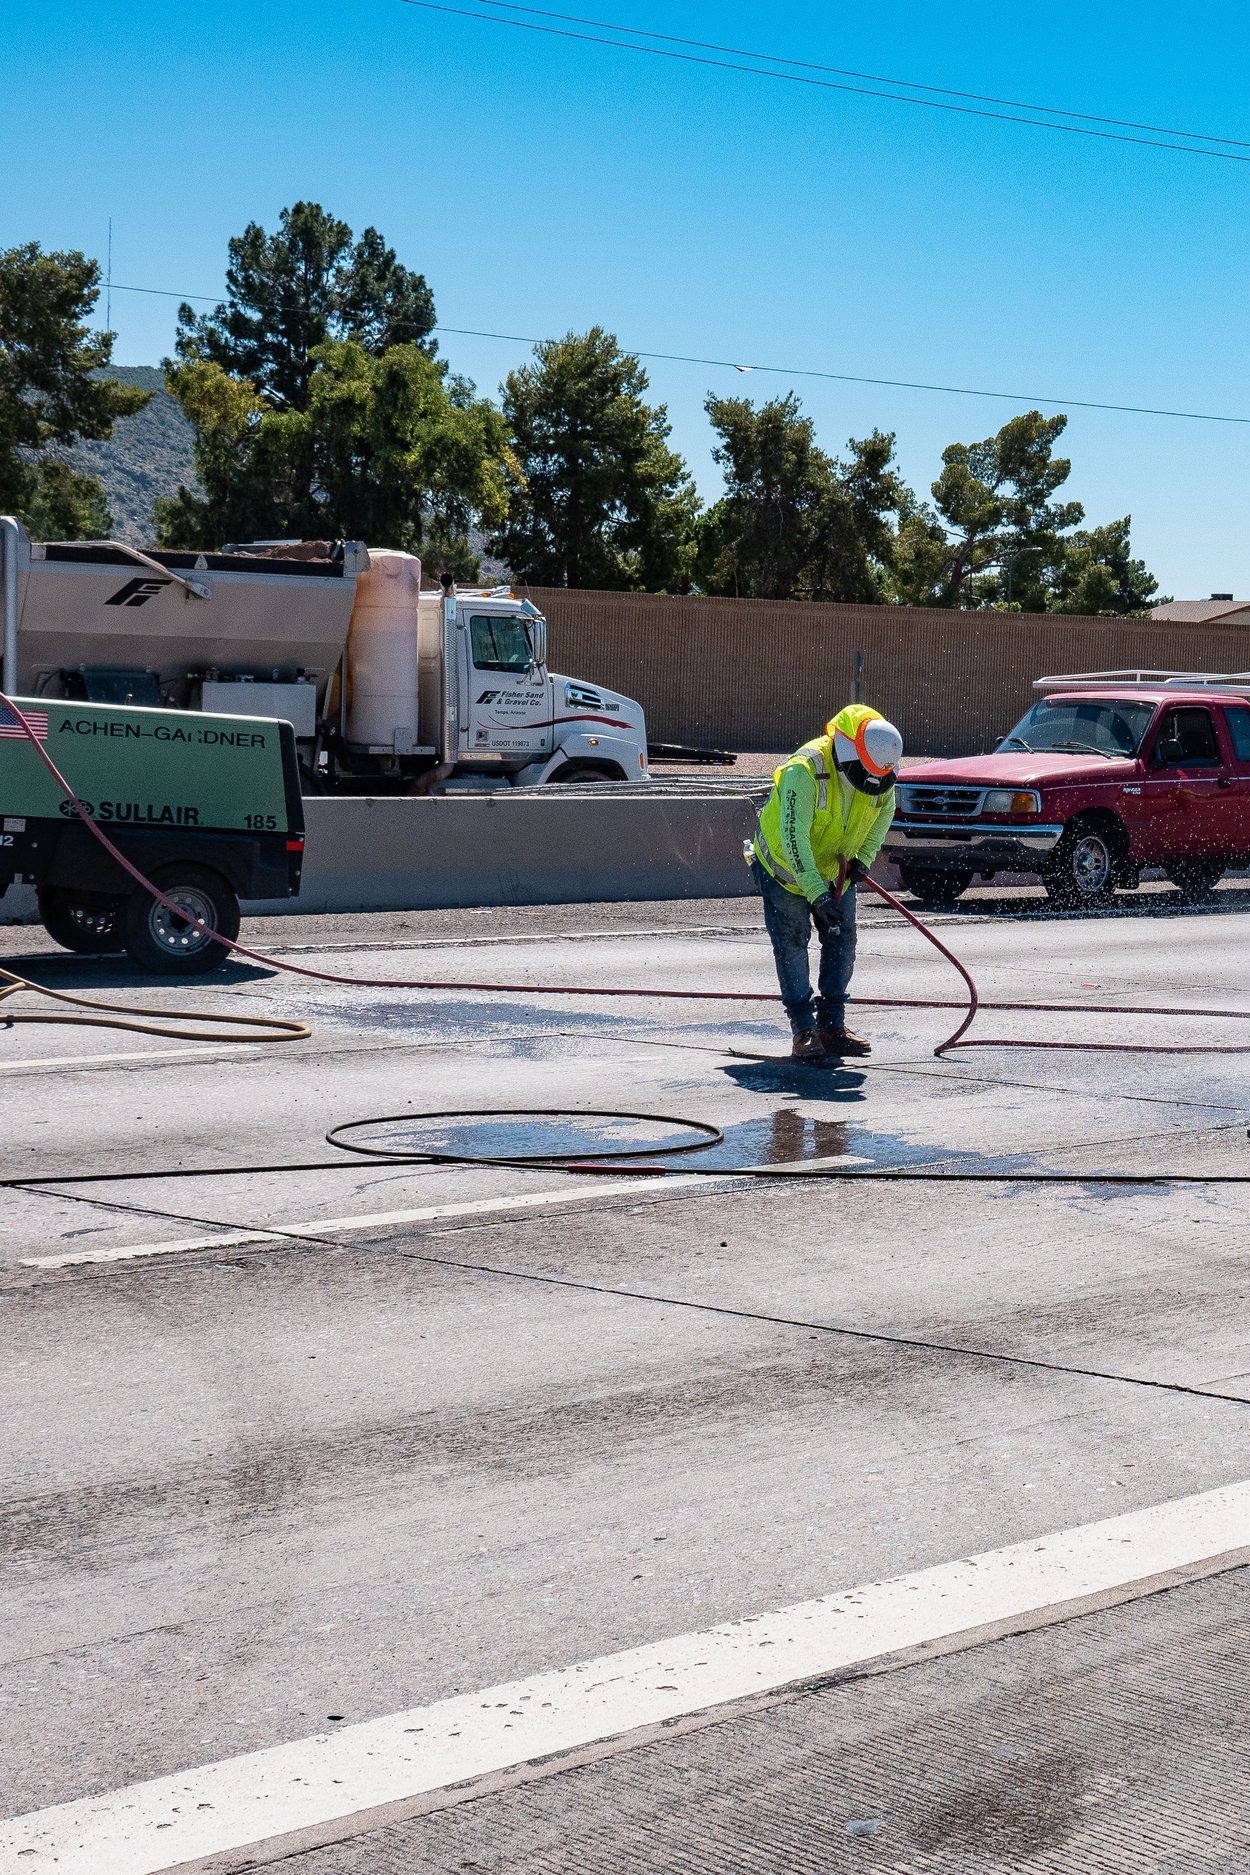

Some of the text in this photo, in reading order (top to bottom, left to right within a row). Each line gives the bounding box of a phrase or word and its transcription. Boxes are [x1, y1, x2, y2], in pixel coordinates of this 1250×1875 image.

[98, 801, 199, 826] SULLAIR
[243, 814, 277, 830] 185
[789, 790, 806, 873] ACHEN-GARDNER
